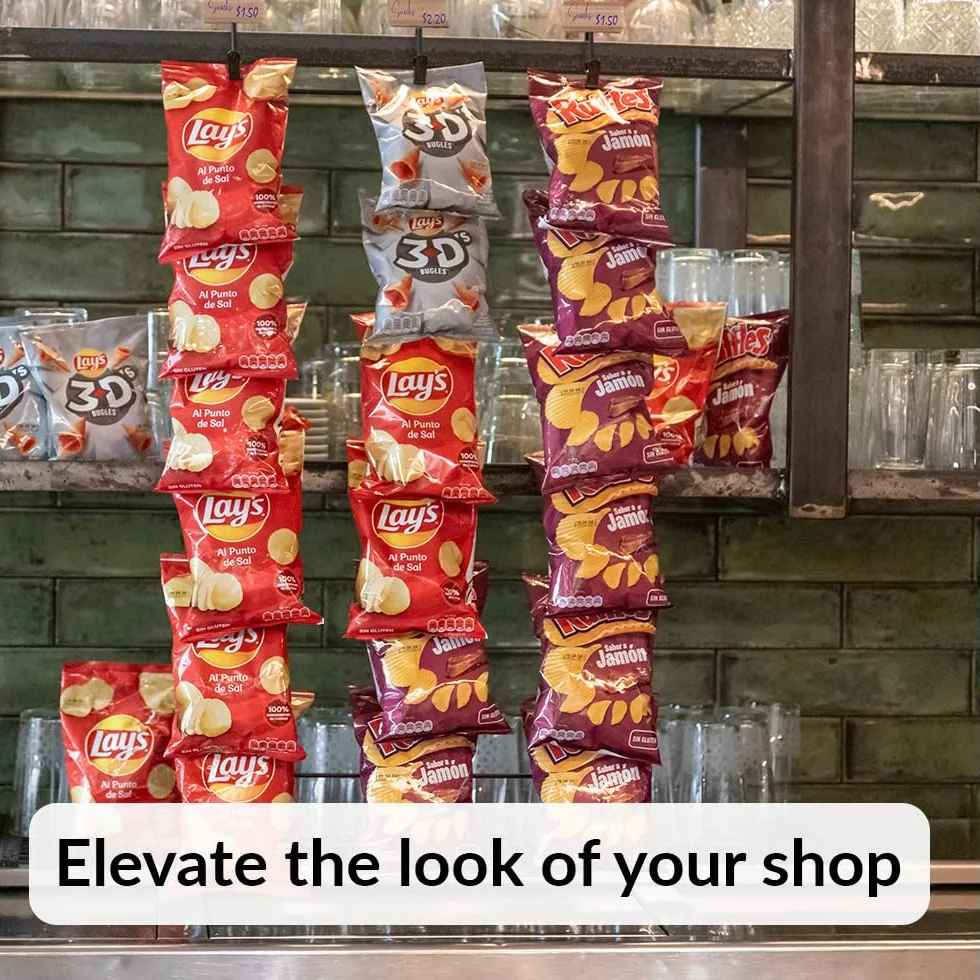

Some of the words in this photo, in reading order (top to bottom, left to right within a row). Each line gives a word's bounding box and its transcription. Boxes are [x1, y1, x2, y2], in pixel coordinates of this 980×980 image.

[236, 6, 259, 18] $1.50
[422, 12, 447, 25] $2.20
[595, 13, 619, 26] $1.50
[187, 118, 248, 150] Lay's
[426, 141, 452, 150] BUGLES
[602, 130, 651, 151] Jamón
[197, 168, 207, 176] Al
[209, 165, 235, 173] Punto
[202, 177, 213, 185] de
[215, 175, 229, 183] Sal
[420, 267, 447, 276] BUGLES
[199, 290, 209, 298] Al
[211, 290, 238, 298] Punto
[204, 301, 215, 309] de
[217, 300, 232, 308] Sal
[387, 370, 447, 401] Lay's
[595, 370, 645, 397] Jamón
[91, 408, 117, 418] BUGLES
[192, 409, 203, 417] Al
[204, 409, 231, 417] Punto
[197, 419, 208, 428] de
[210, 419, 225, 428] Sal
[401, 420, 411, 428] Al
[414, 420, 440, 428] Punto
[408, 430, 419, 439] de
[421, 430, 435, 439] Sal
[203, 495, 264, 527] Lay's
[377, 503, 439, 534] Lay's
[217, 548, 227, 556] Al
[229, 546, 257, 555] Punto
[223, 558, 235, 567] de
[237, 556, 252, 566] Sal
[388, 554, 398, 562] Al
[400, 553, 428, 561] Punto
[393, 563, 405, 571] de
[406, 563, 421, 571] Sal
[596, 643, 648, 668] Jamón
[209, 674, 219, 682] Al
[221, 673, 249, 682] Punto
[214, 684, 226, 693] de
[228, 684, 243, 693] Sal
[91, 728, 149, 761] Lay's
[420, 759, 469, 786] Jamón
